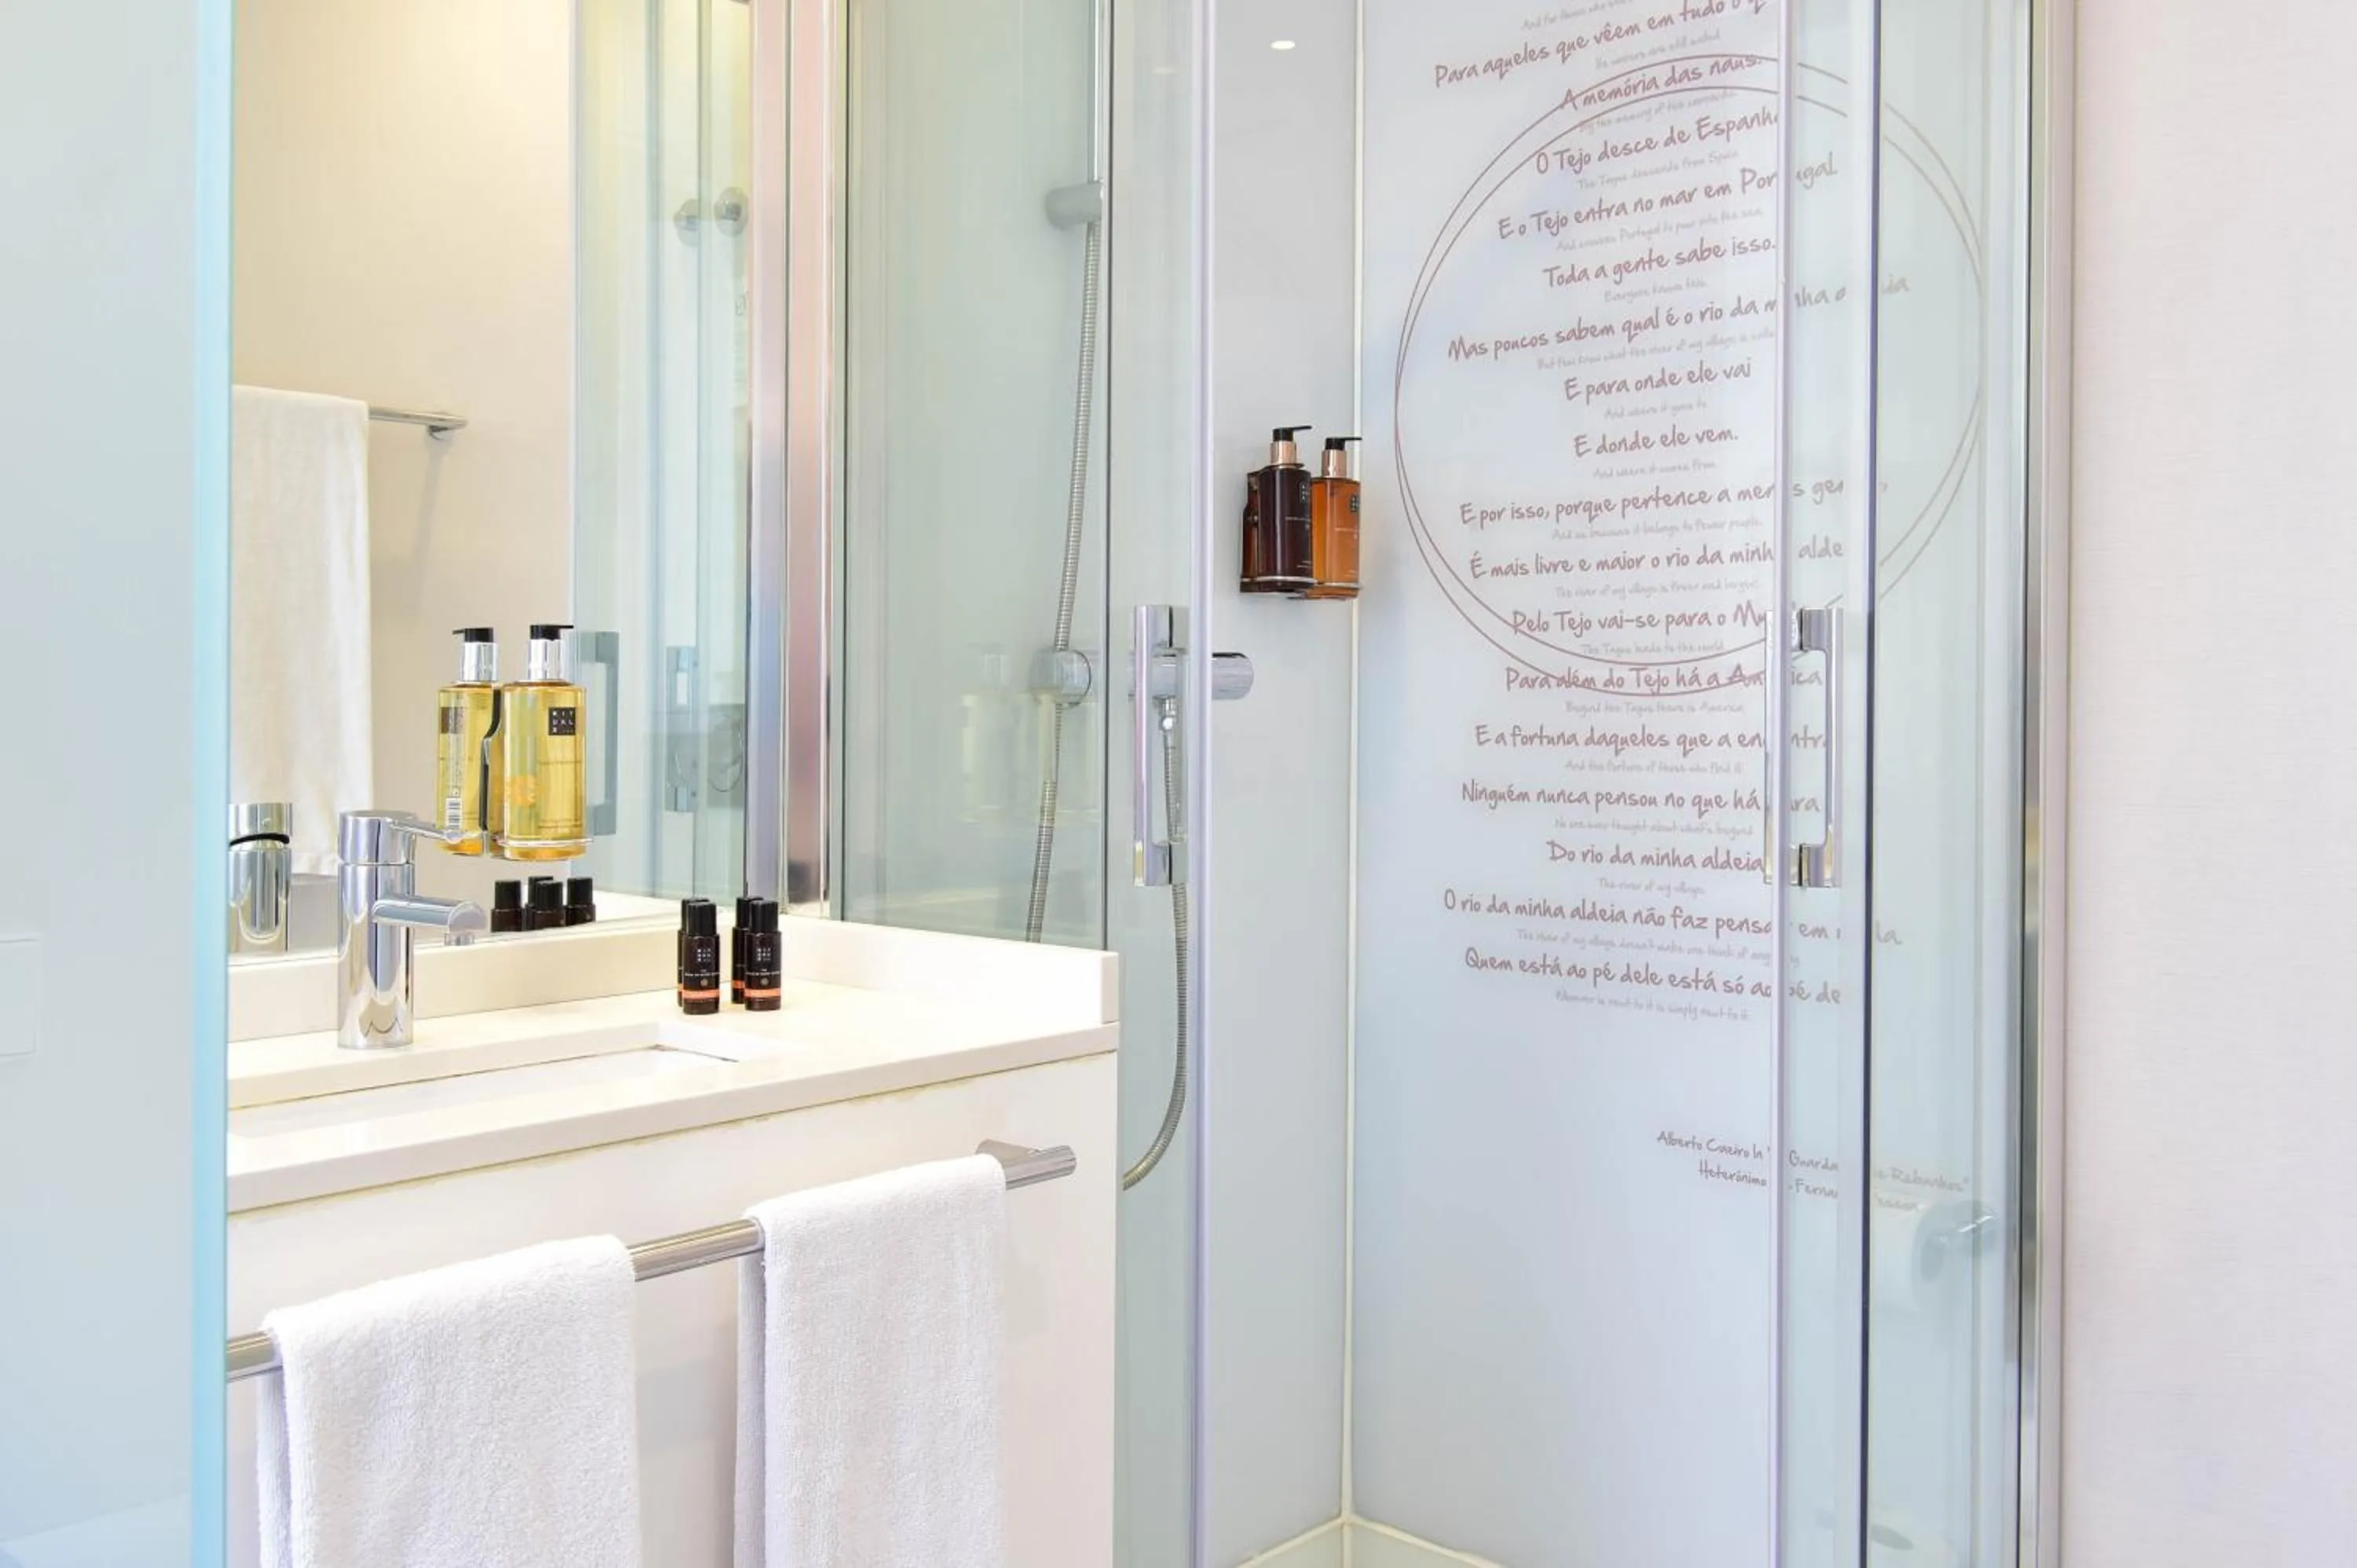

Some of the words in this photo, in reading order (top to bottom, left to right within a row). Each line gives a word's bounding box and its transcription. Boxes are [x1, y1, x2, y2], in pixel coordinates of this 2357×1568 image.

[1434, 64, 1478, 89] Para
[1483, 42, 1549, 79] aqueles
[1556, 36, 1589, 63] que
[1593, 24, 1641, 45] vêem
[1647, 13, 1674, 31] em
[1679, 0, 1724, 22] tudo
[1560, 89, 1578, 111] A
[1582, 75, 1660, 107] memória
[1663, 64, 1703, 86] das
[1535, 151, 1549, 174] O
[1555, 147, 1592, 175] Tejo
[1596, 124, 1660, 162] desce
[1662, 124, 1691, 149] de
[1497, 217, 1516, 240] E
[1519, 225, 1527, 236] o
[1530, 210, 1569, 237] Tejo
[1574, 196, 1629, 225] entra
[1633, 196, 1654, 213] no
[1659, 185, 1699, 210] mar
[1704, 181, 1732, 200] em
[1740, 151, 1838, 195] Porgal
[1541, 262, 1589, 288] Toda
[1594, 264, 1607, 279] a
[1614, 248, 1670, 285] gente
[1675, 241, 1726, 266] sabe
[1731, 235, 1776, 258] isso.
[1447, 334, 1489, 362] Mas
[1494, 330, 1549, 361] poucos
[1556, 317, 1615, 343] sabem
[1620, 306, 1659, 343] qual
[1665, 307, 1679, 327] é
[1684, 312, 1693, 325] o
[1699, 302, 1724, 323] rio
[1730, 295, 1759, 317] da
[1563, 376, 1581, 401] E
[1585, 378, 1630, 405] para
[1634, 368, 1683, 391] onde
[1686, 360, 1718, 383] ele
[1722, 357, 1752, 379] vai
[1573, 433, 1591, 458] E
[1595, 430, 1656, 455] donde
[1659, 424, 1691, 448] ele
[1695, 427, 1739, 445] vem.
[1459, 502, 1477, 526] E
[1479, 506, 1505, 530] por
[1509, 502, 1550, 521] isso,
[1554, 494, 1618, 524] porque
[1620, 484, 1713, 520] pertence
[1716, 487, 1732, 502] a
[1469, 551, 1487, 579] É
[1490, 555, 1530, 578] mais
[1534, 552, 1574, 575] livre
[1578, 558, 1593, 573] e
[1595, 549, 1645, 571] maior
[1650, 553, 1660, 568] o
[1666, 548, 1690, 567] rio
[1695, 544, 1725, 566] da
[1728, 541, 1774, 564] minh
[1798, 534, 1843, 559] alde
[1511, 610, 1550, 636] Pelo
[1552, 609, 1593, 638] Tejo
[1596, 609, 1661, 629] vai-se
[1664, 612, 1712, 635] para
[1717, 613, 1727, 627] o
[1505, 666, 1552, 692] Para
[1555, 665, 1598, 690] além
[1601, 667, 1626, 689] do
[1628, 666, 1671, 696] Tejo
[1675, 665, 1703, 688] há
[1706, 670, 1721, 688] a
[1475, 724, 1492, 747] E
[1494, 731, 1508, 748] a
[1510, 723, 1581, 749] fortuna
[1583, 724, 1670, 757] daqueles
[1675, 731, 1714, 760] que
[1717, 731, 1732, 748] a
[1461, 778, 1531, 811] Ninguém
[1536, 787, 1590, 806] nunca
[1594, 789, 1659, 814] pensou
[1663, 789, 1686, 808] no
[1690, 793, 1728, 821] que
[1732, 786, 1761, 811] há
[1545, 839, 1575, 863] Do
[1579, 842, 1604, 864] rio
[1608, 843, 1636, 867] da
[1640, 843, 1697, 870] minha
[1701, 844, 1764, 873] aldeia
[1443, 888, 1457, 910] O
[1461, 892, 1483, 914] rio
[1486, 893, 1512, 917] da
[1513, 897, 1567, 920] minha
[1570, 898, 1628, 925] aldeia
[1632, 906, 1666, 929] não
[1669, 905, 1710, 932] faz
[1714, 917, 1792, 940] pensa
[1798, 922, 1829, 940] em
[1464, 946, 1514, 972] Quem
[1518, 952, 1563, 978] está
[1567, 963, 1587, 980] ao
[1591, 960, 1616, 989] pé
[1619, 960, 1665, 987] dele
[1667, 965, 1718, 993] está
[1721, 975, 1745, 995] só
[1656, 1130, 1703, 1150] Alberto
[1788, 1149, 1839, 1171] Guarda
